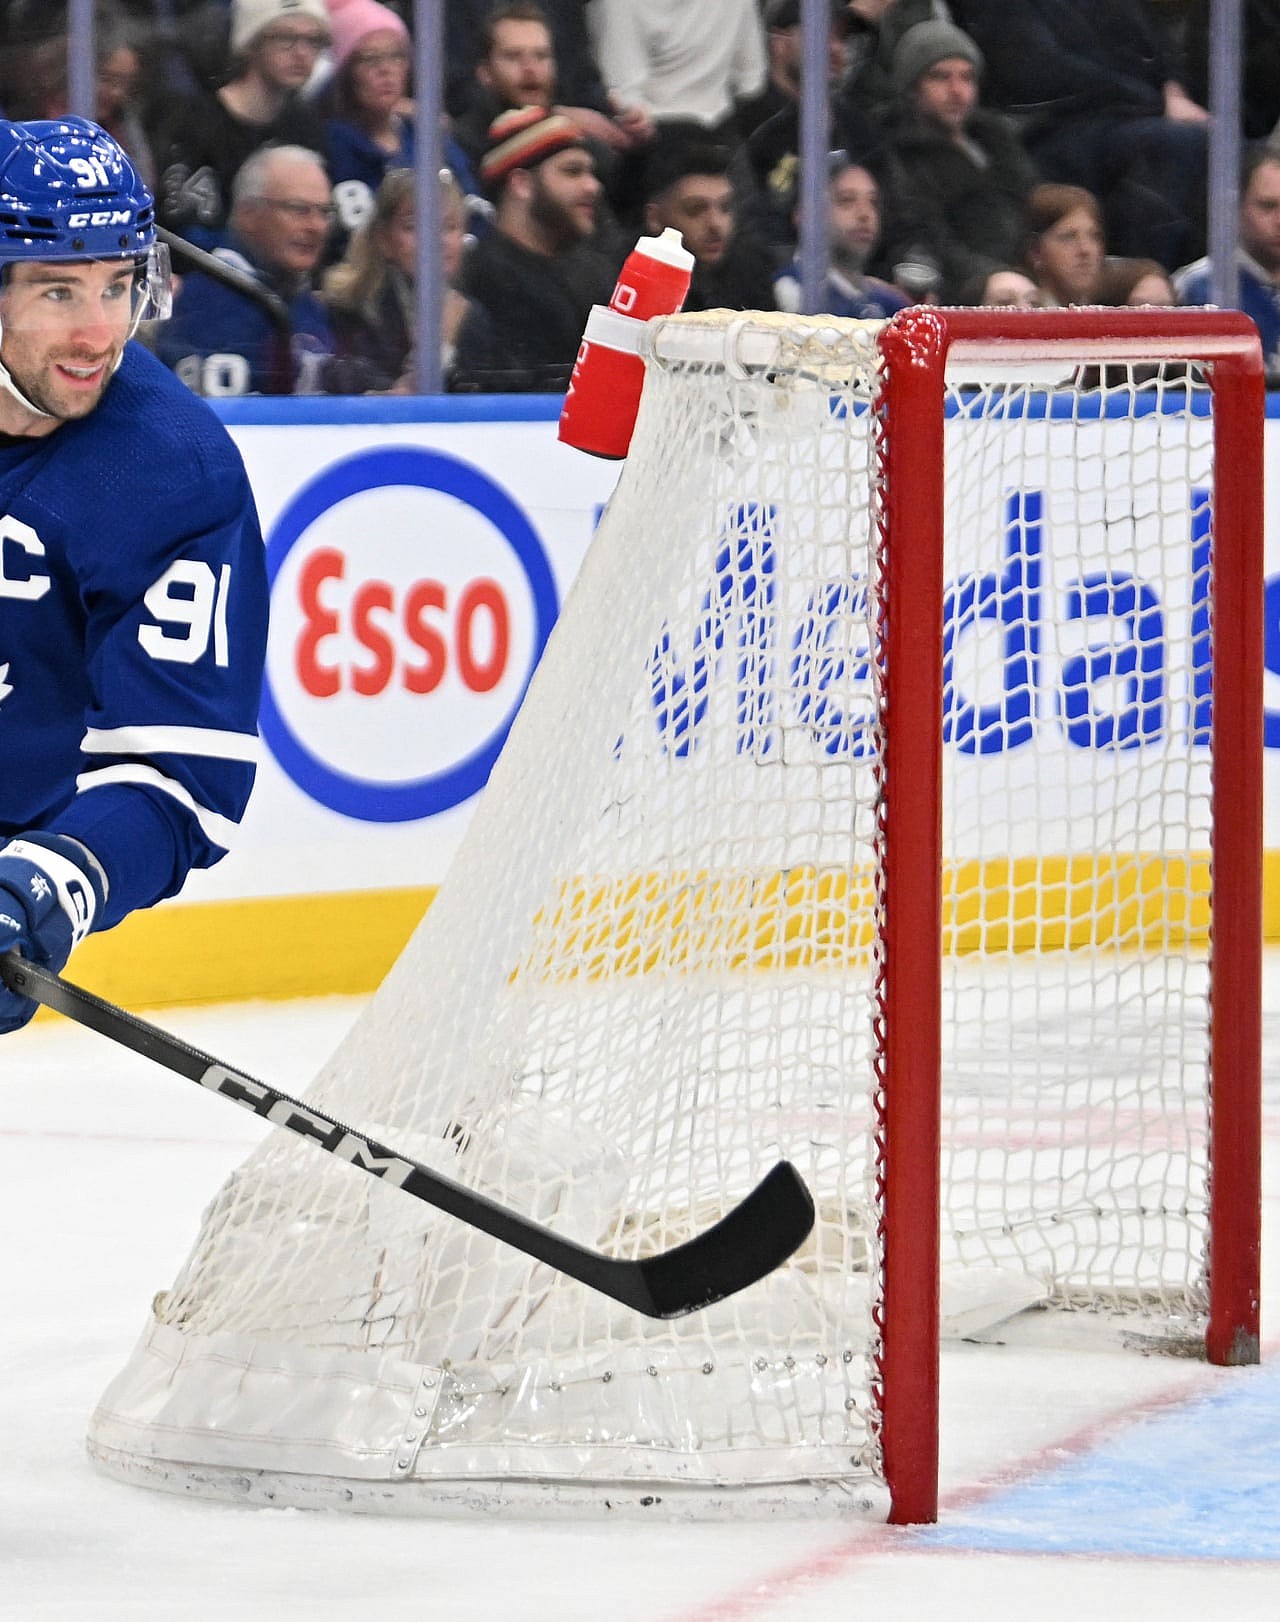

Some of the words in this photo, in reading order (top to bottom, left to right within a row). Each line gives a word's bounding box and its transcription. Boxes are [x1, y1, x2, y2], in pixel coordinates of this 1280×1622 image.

[68, 210, 132, 228] CCM
[69, 156, 110, 188] 91
[138, 559, 231, 667] 91
[295, 546, 510, 699] Esso
[200, 1064, 415, 1190] CCM
